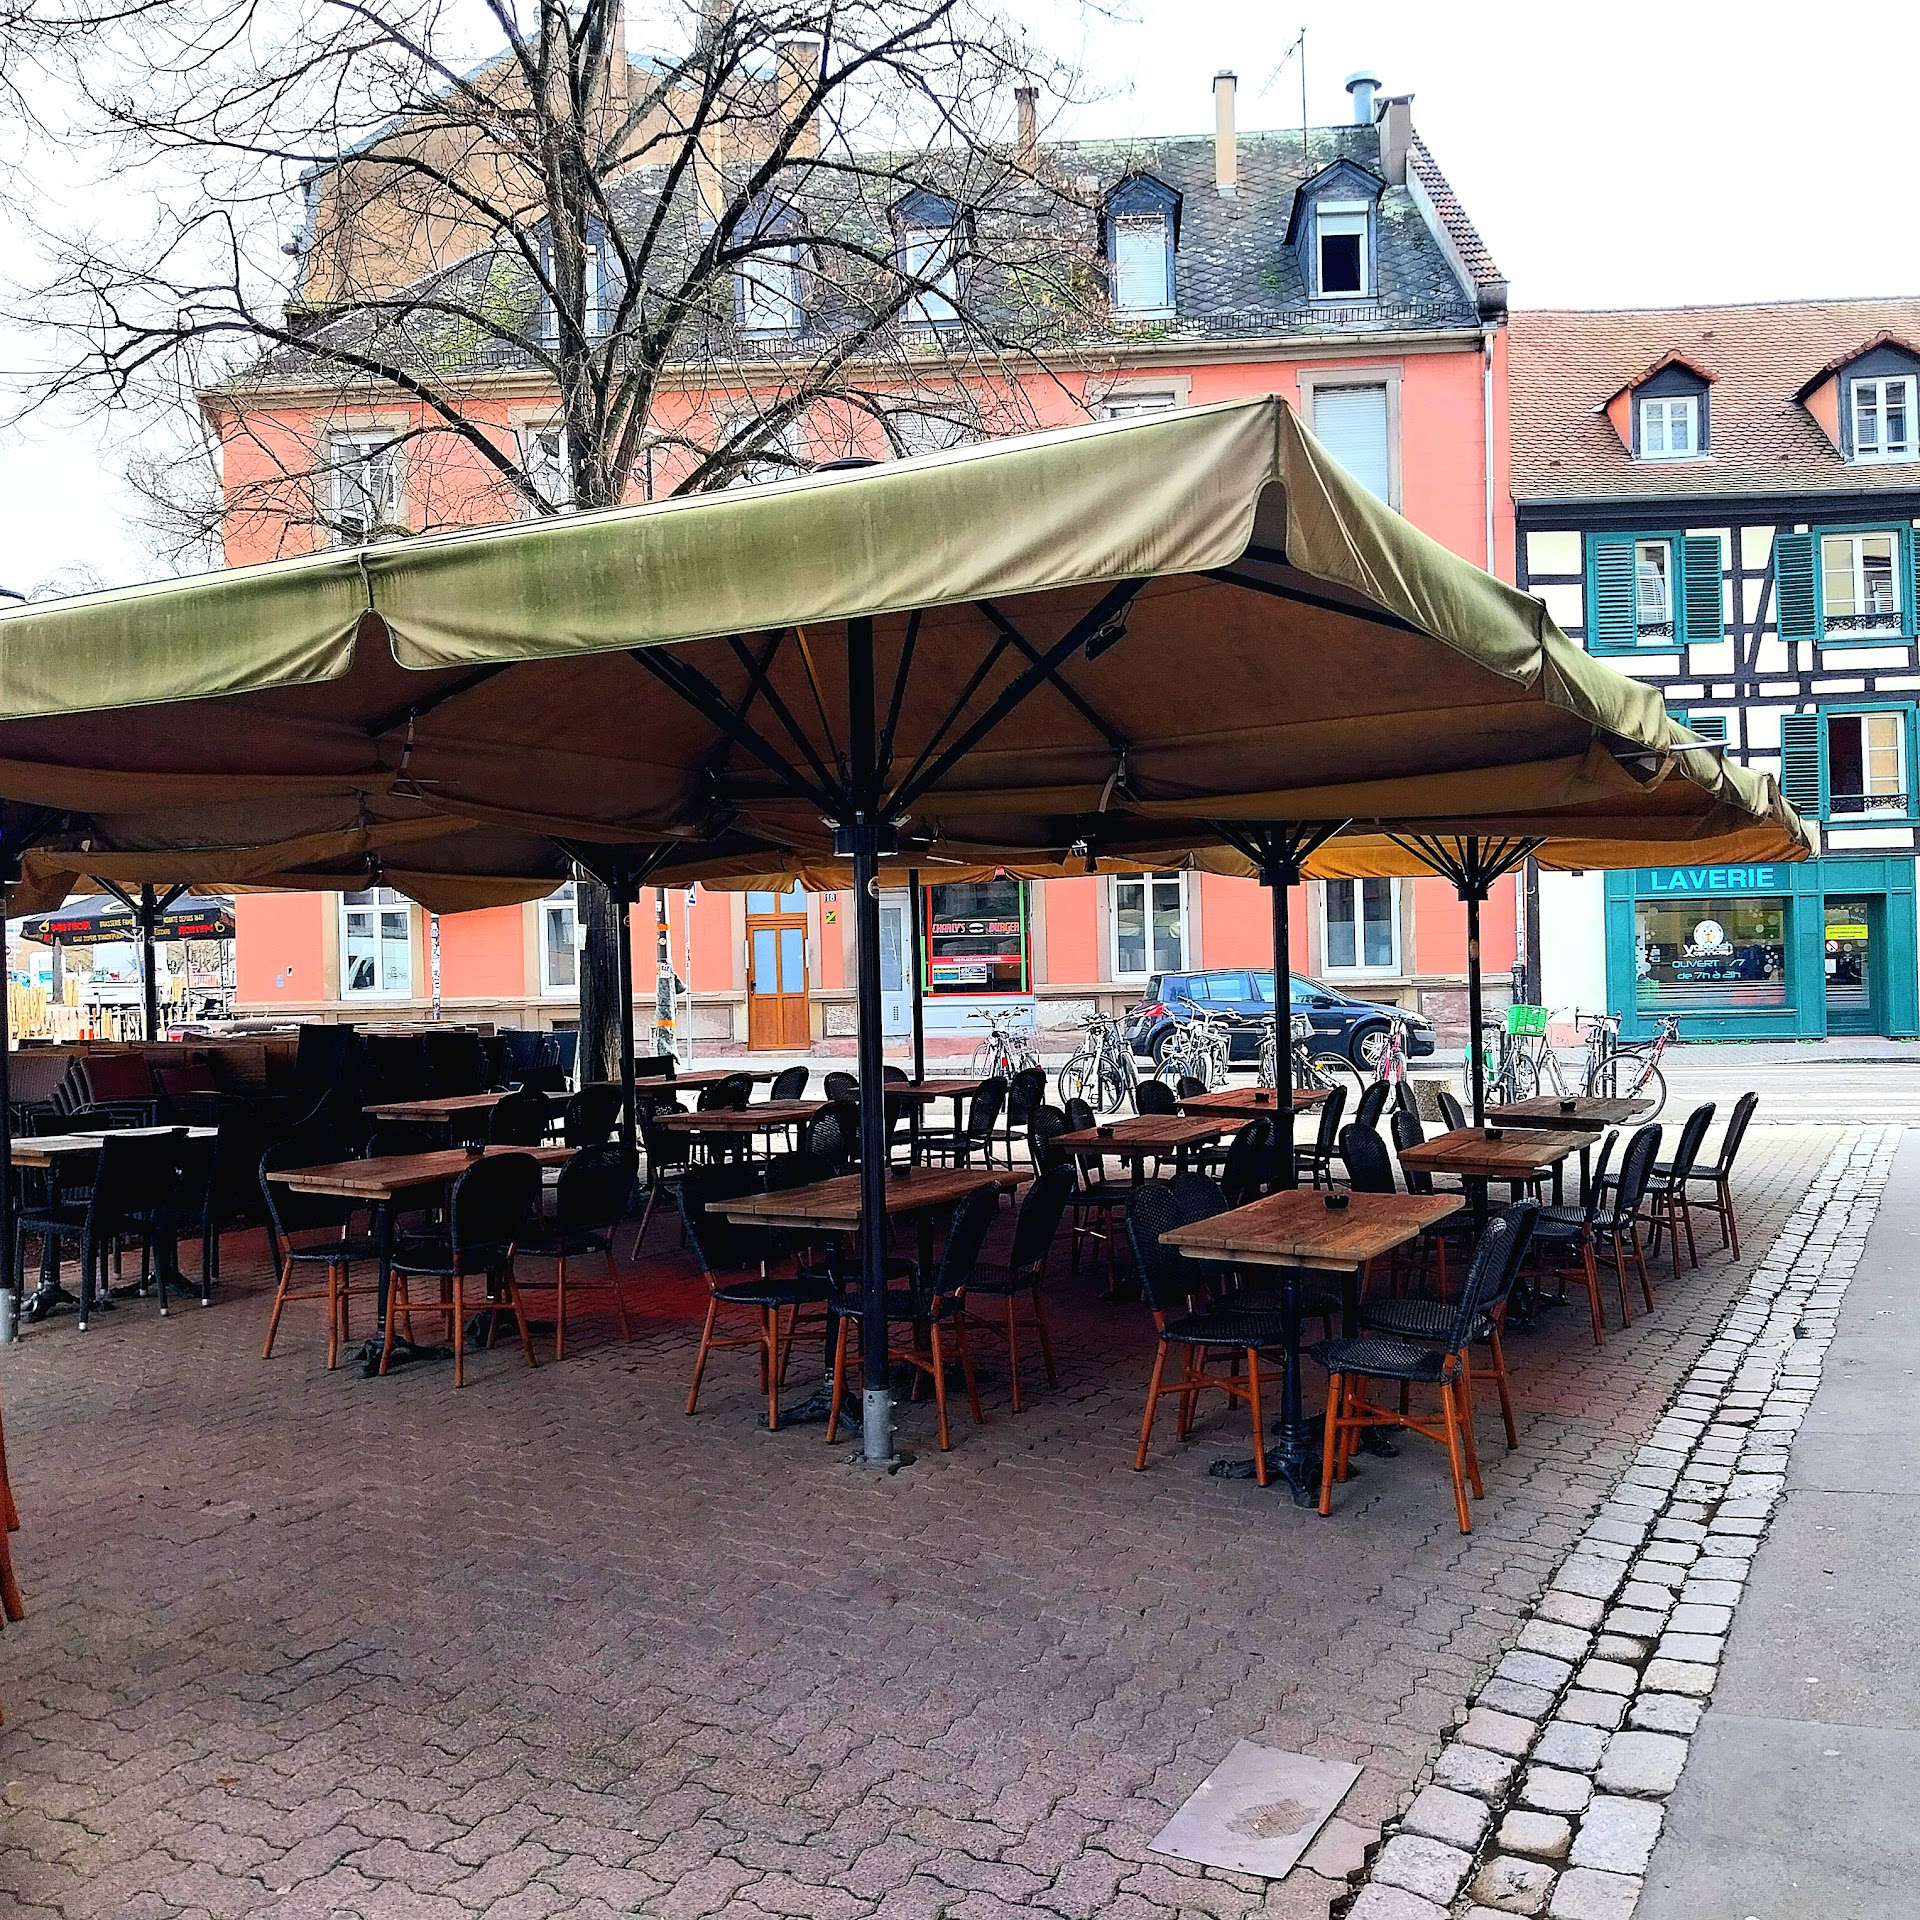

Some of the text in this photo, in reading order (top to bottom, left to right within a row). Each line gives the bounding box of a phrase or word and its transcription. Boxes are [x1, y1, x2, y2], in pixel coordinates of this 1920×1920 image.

[1651, 867, 1775, 891] LAVERIE
[825, 893, 837, 902] 18
[51, 920, 91, 932] METEOR
[932, 921, 1020, 933] CHARLY'S BURGER
[1672, 959, 1720, 969] OUVERT
[1677, 972, 1693, 980] de
[1694, 971, 1711, 979] 7h
